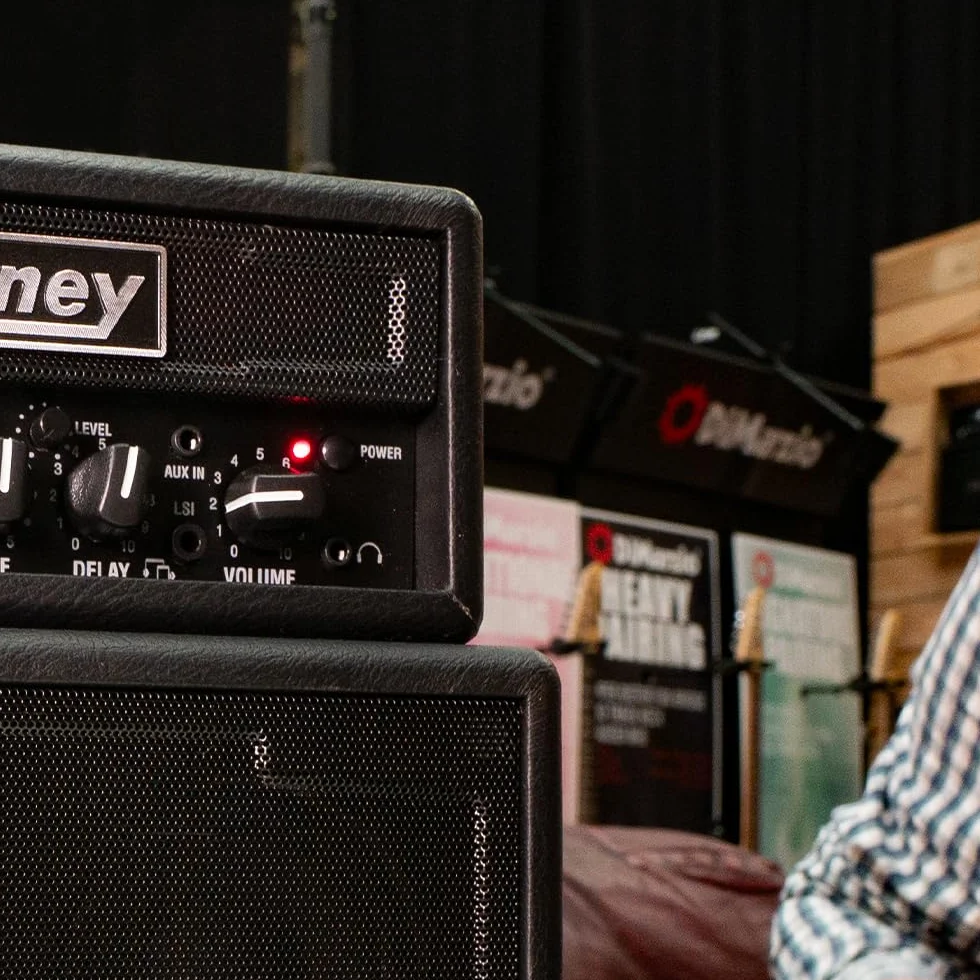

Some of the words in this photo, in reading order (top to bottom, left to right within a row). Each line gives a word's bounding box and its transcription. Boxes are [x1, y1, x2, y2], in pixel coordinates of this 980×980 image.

[74, 421, 112, 437] LEVEL
[256, 447, 264, 461] 5
[360, 444, 402, 460] POWER
[230, 454, 238, 467] 4
[54, 461, 63, 476] 3
[164, 464, 189, 479] AUX
[193, 466, 205, 480] IN
[213, 471, 222, 484] 3
[173, 501, 195, 516] LSI
[209, 497, 218, 511] 2
[216, 524, 222, 537] 1
[71, 537, 80, 551] 0
[230, 544, 238, 558] 0
[72, 560, 130, 577] DELAY
[223, 567, 296, 585] VOLUME
